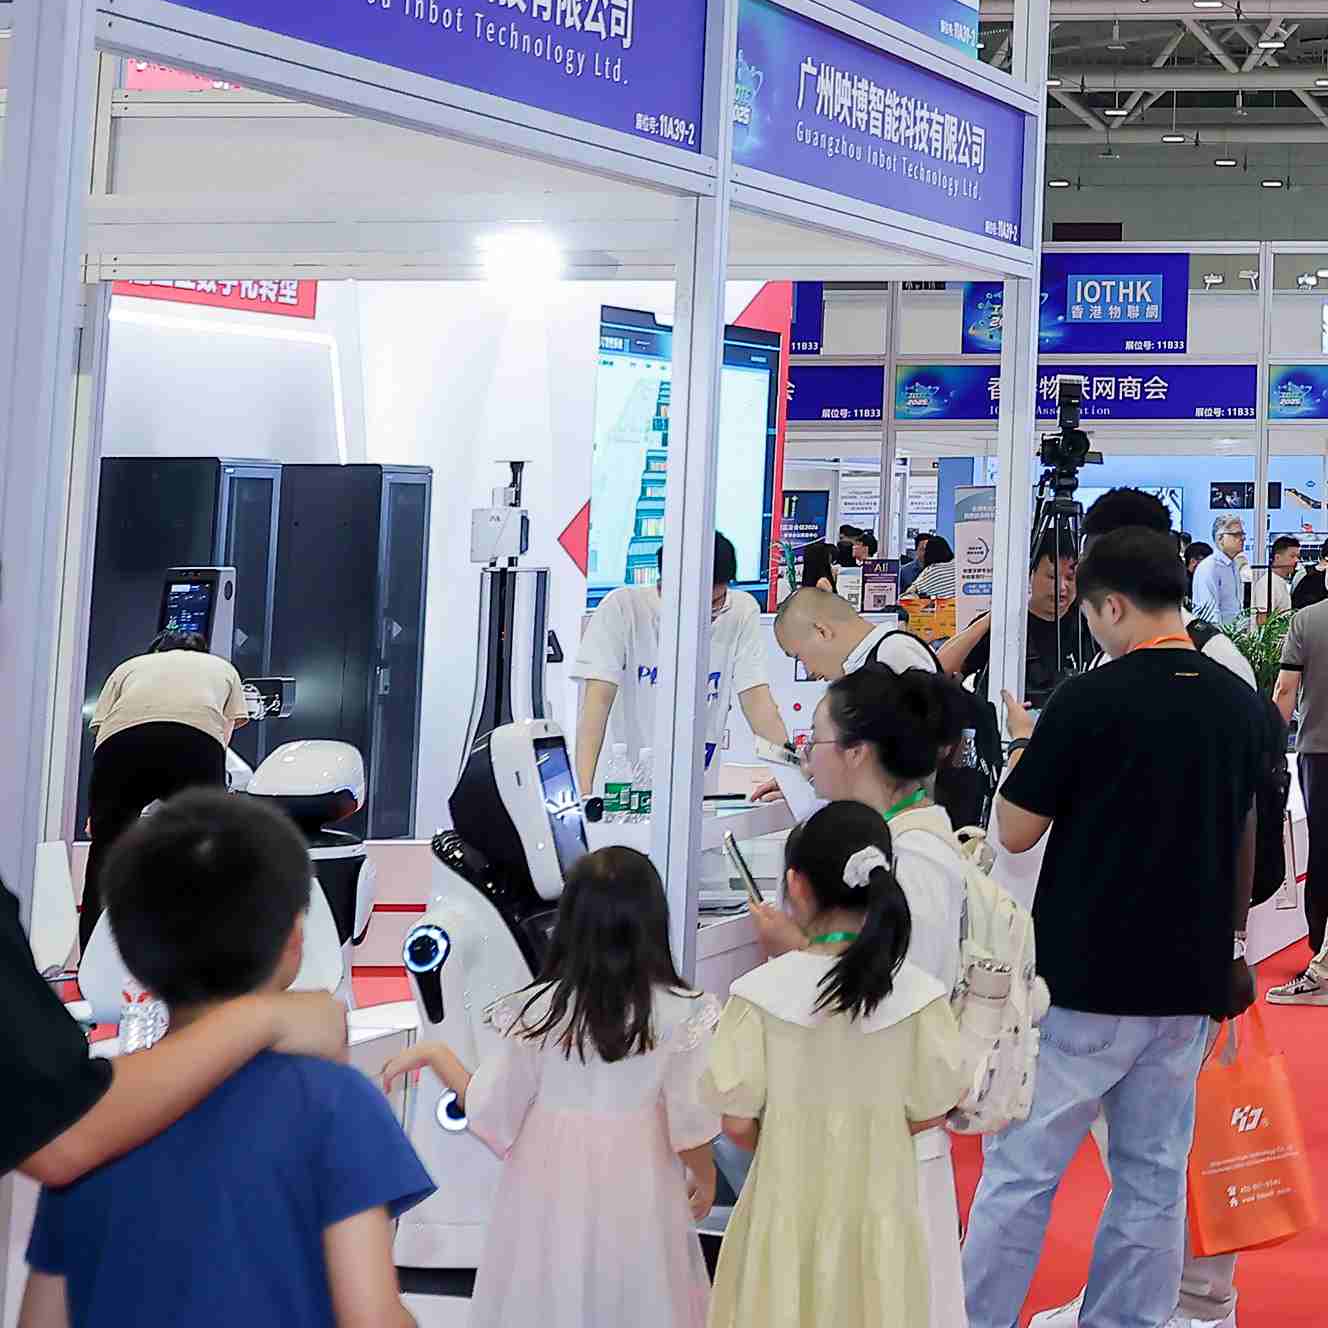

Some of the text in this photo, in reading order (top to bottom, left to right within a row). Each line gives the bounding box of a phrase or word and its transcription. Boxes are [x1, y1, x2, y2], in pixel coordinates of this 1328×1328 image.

[474, 11, 586, 78] Technology
[594, 51, 630, 85] Ltd.
[797, 56, 986, 174] 广州映博智能科技有限公司
[796, 120, 982, 201] Guangzhou Inbot Technology Ltd.
[1075, 280, 1153, 303] IOTHK
